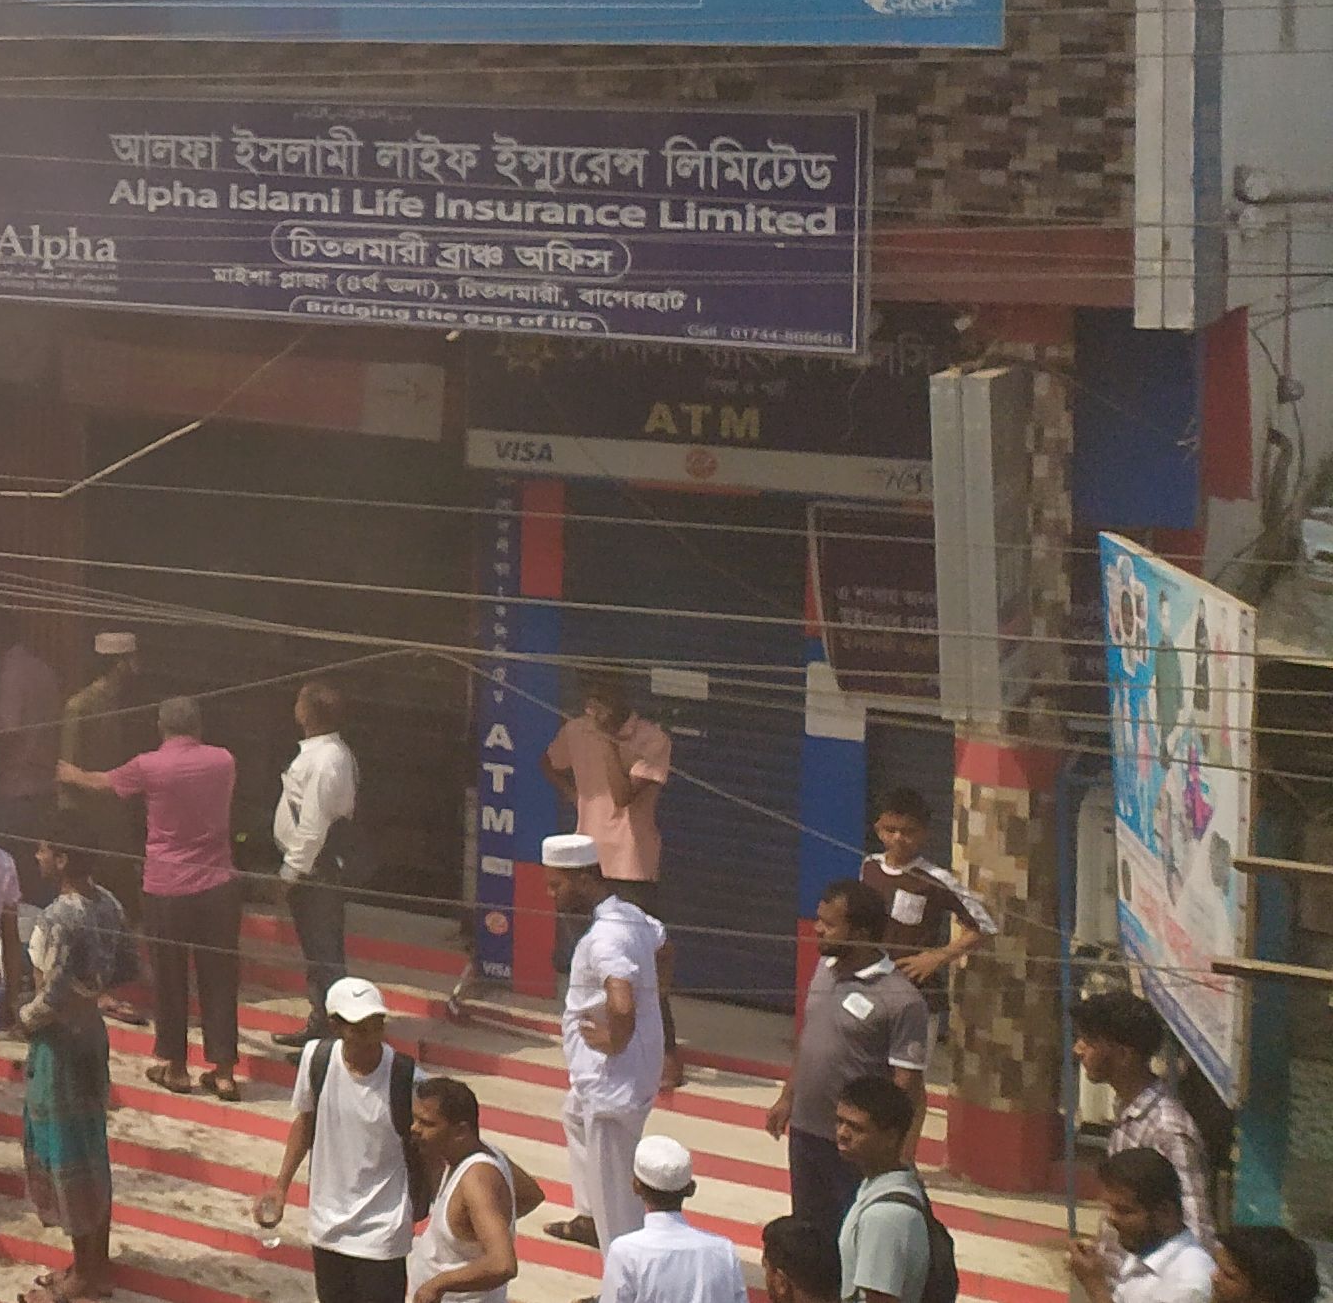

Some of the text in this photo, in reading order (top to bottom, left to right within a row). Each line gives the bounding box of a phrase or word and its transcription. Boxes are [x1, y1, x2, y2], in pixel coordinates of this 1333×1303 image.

[109, 131, 222, 171] আলফা
[230, 124, 363, 177] ইসলামী
[374, 128, 481, 184] লাইফ
[661, 135, 837, 191] লিমিটেড
[109, 179, 836, 237] Alpha Islami Life Insurance Limited
[287, 227, 614, 273] চিতলমারী ব্রাঞ্চ অফিস
[306, 300, 594, 331] Bridging the gap of life
[579, 287, 689, 314] বাগেরহাট
[643, 400, 761, 439] ATM
[494, 439, 554, 463] VISA
[482, 723, 515, 835] ATM
[483, 961, 512, 978] VISA
